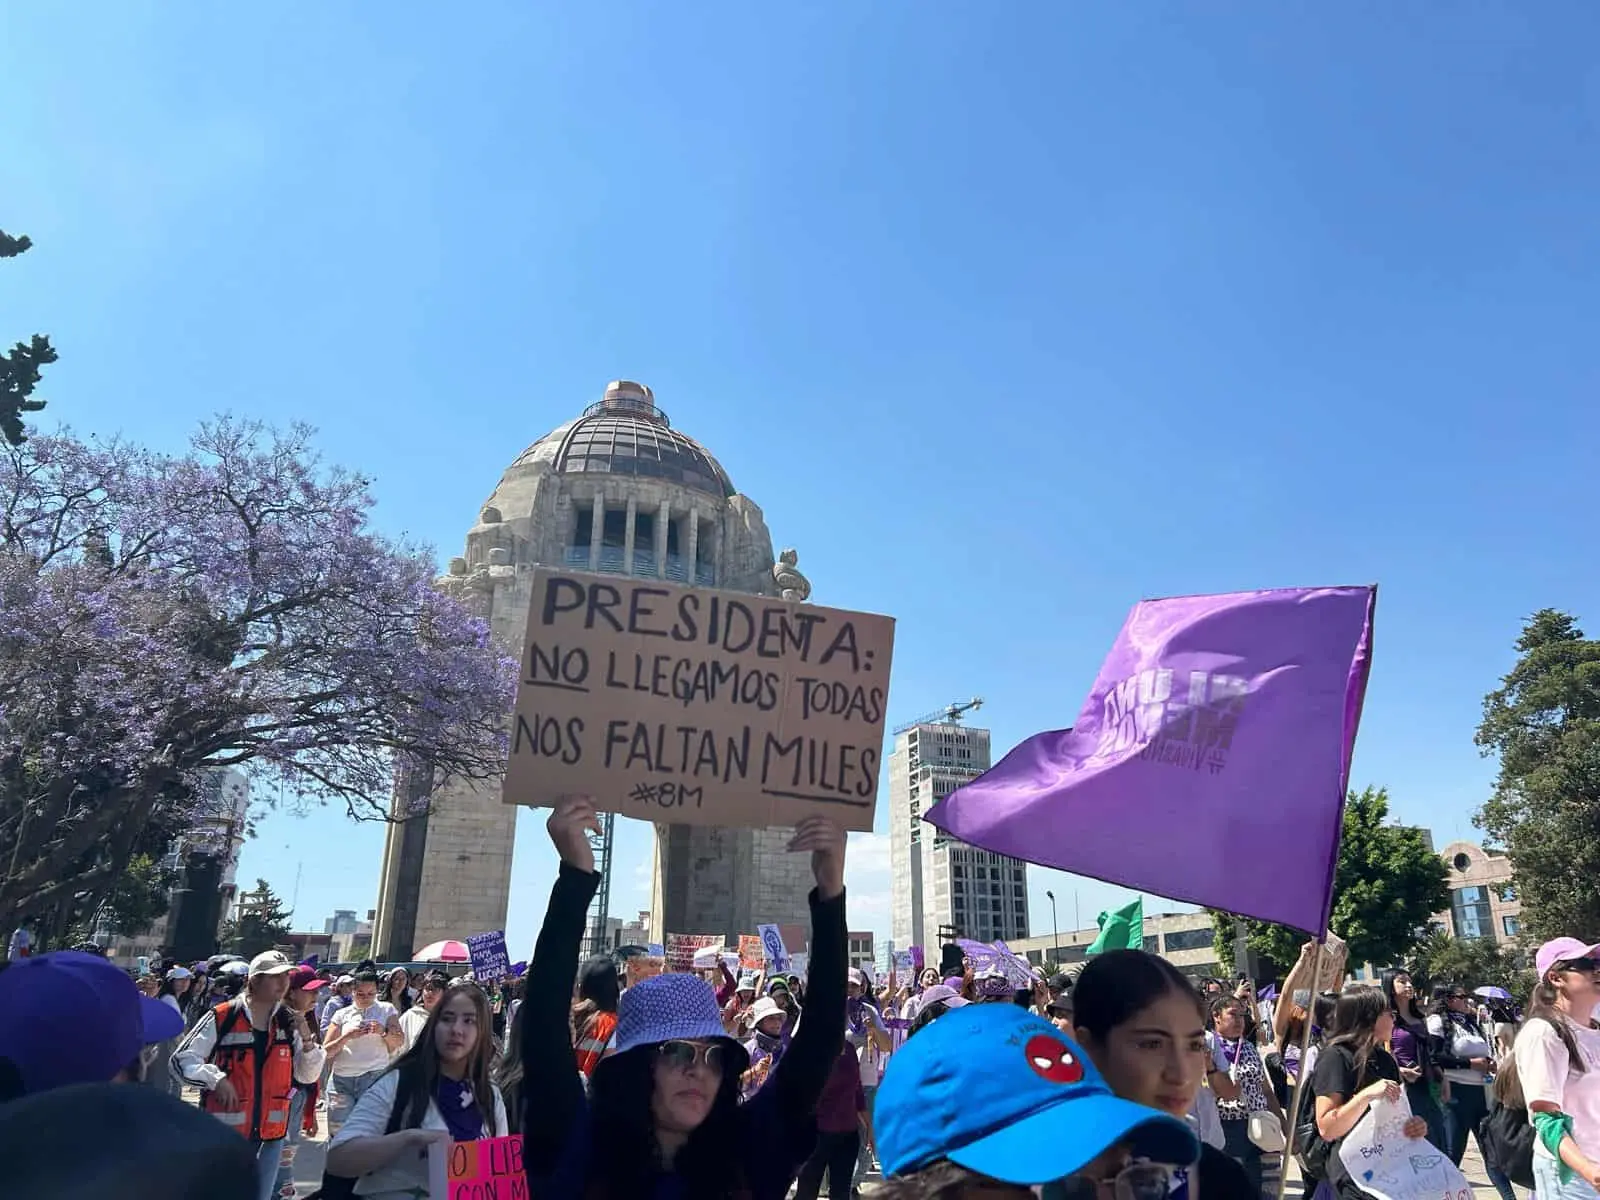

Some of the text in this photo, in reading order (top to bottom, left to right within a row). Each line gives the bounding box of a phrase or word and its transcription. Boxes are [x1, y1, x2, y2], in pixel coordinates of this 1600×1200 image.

[542, 577, 875, 674] PRESIDENTA:
[530, 642, 884, 725] NO LLEGAMOS TODAS
[513, 713, 877, 798] NOS FALTAN MILES
[629, 781, 703, 808] #8M
